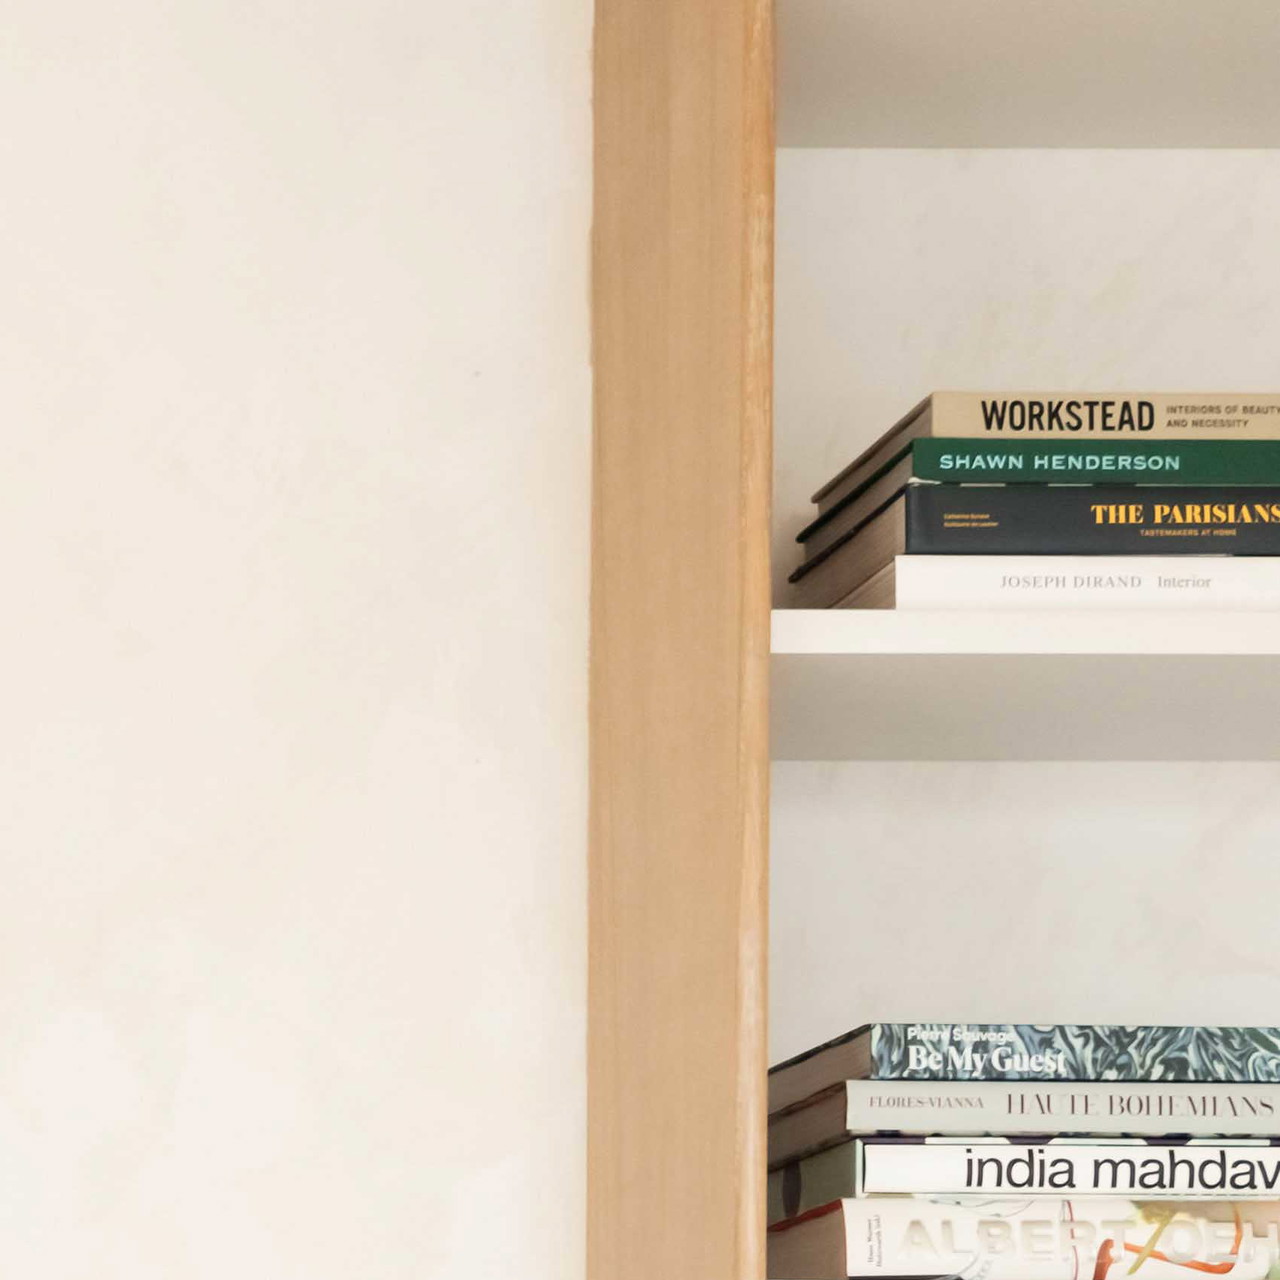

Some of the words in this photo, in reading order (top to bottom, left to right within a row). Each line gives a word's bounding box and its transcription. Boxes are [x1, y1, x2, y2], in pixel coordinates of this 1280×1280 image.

[981, 400, 1155, 432] WORKSTEAD
[1166, 405, 1222, 415] INTERIORS
[1192, 419, 1249, 429] NECESSITY
[939, 455, 1023, 470] SHAWN
[1034, 455, 1180, 470] HENDERSON
[1090, 504, 1144, 524] THE
[1153, 503, 1280, 525] PARISIANS
[1000, 575, 1066, 588] JOSEPH
[1073, 575, 1142, 588] DIRAND
[1157, 575, 1212, 588] Interior
[908, 1045, 943, 1071] Be
[946, 1046, 988, 1076] My
[991, 1046, 1066, 1074] Guest
[1006, 1093, 1099, 1115] HAUTE
[1108, 1094, 1274, 1116] BOHEMIANS
[965, 1148, 1076, 1188] india
